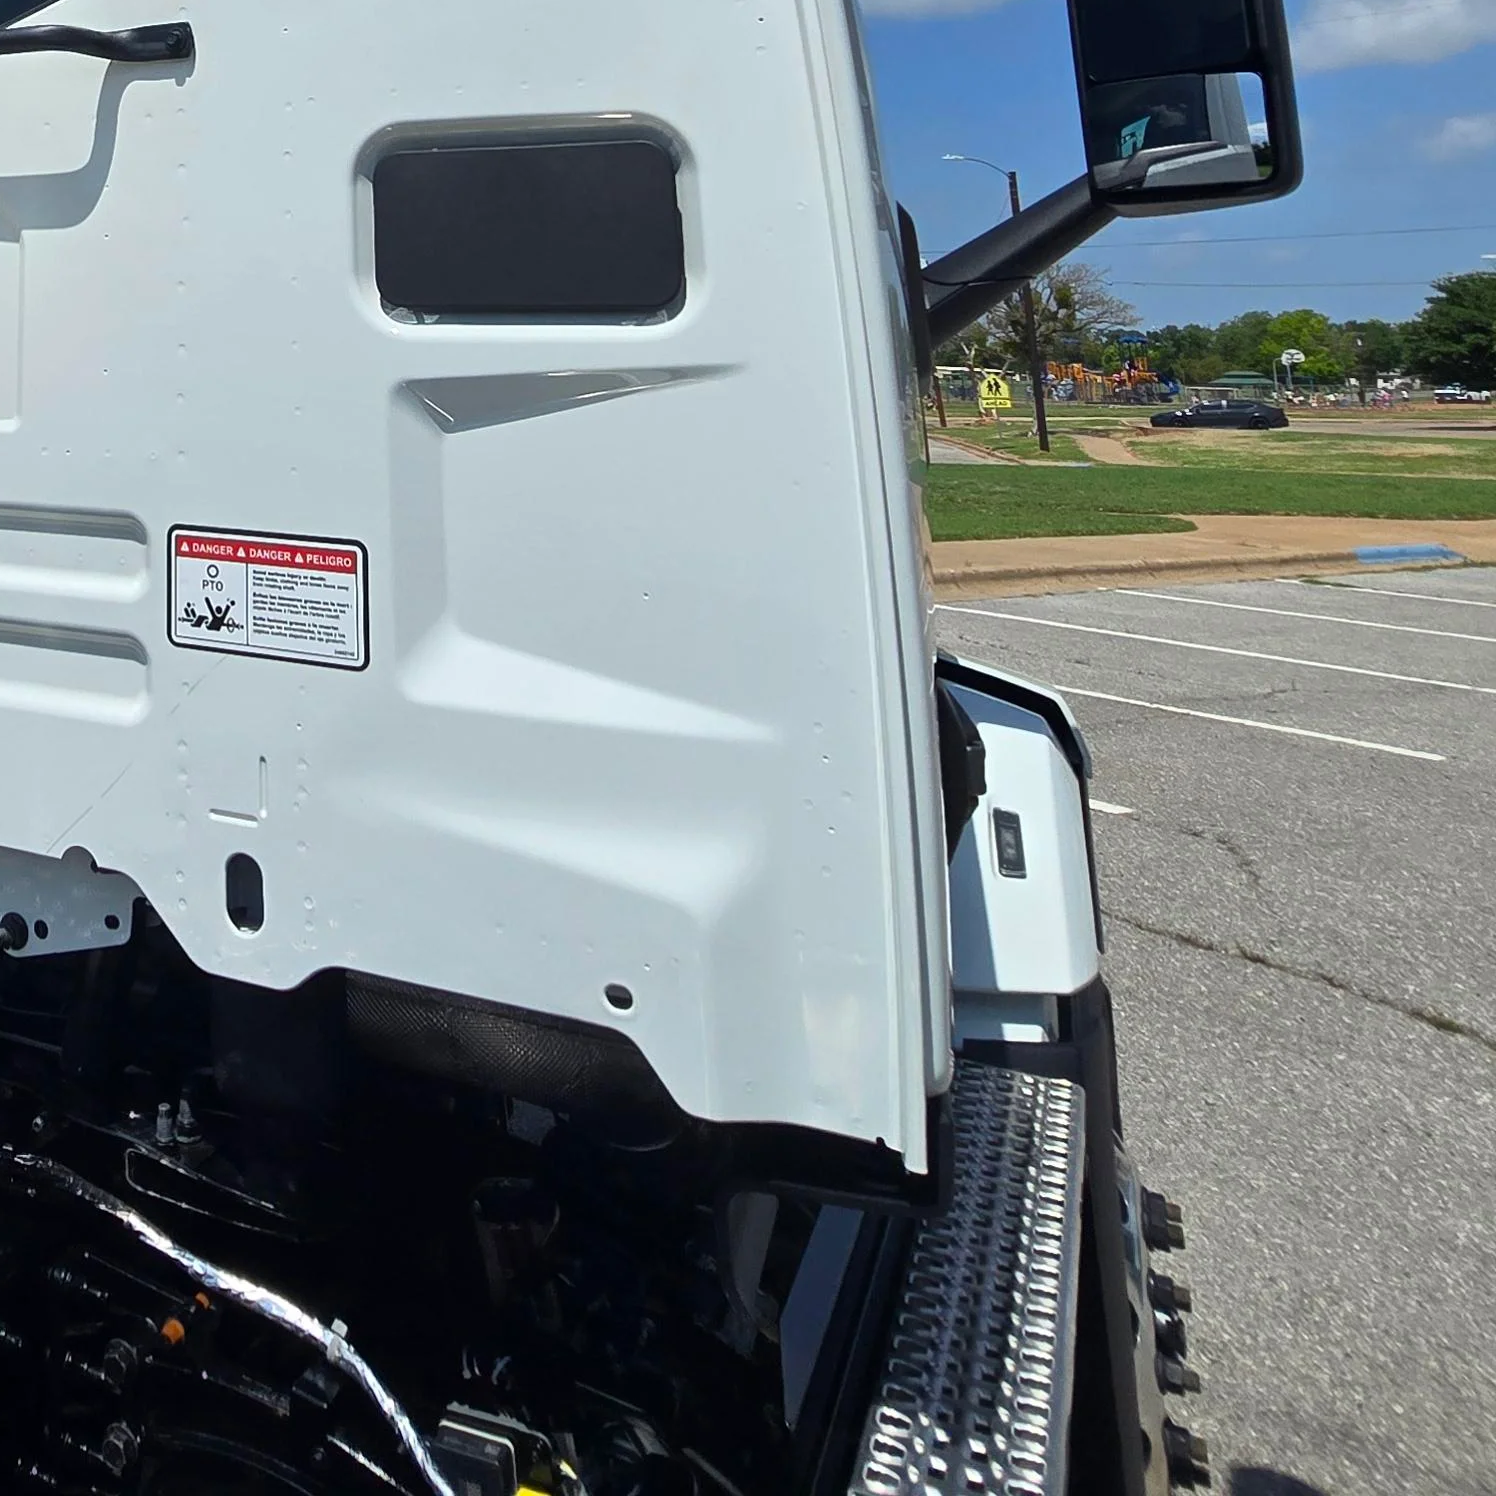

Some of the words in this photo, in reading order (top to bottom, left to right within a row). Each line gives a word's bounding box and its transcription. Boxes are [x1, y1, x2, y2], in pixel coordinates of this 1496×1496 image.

[192, 542, 234, 556] DANGER
[249, 548, 292, 562] DANGER
[306, 553, 352, 567] PELIGRO
[202, 579, 224, 592] PTO
